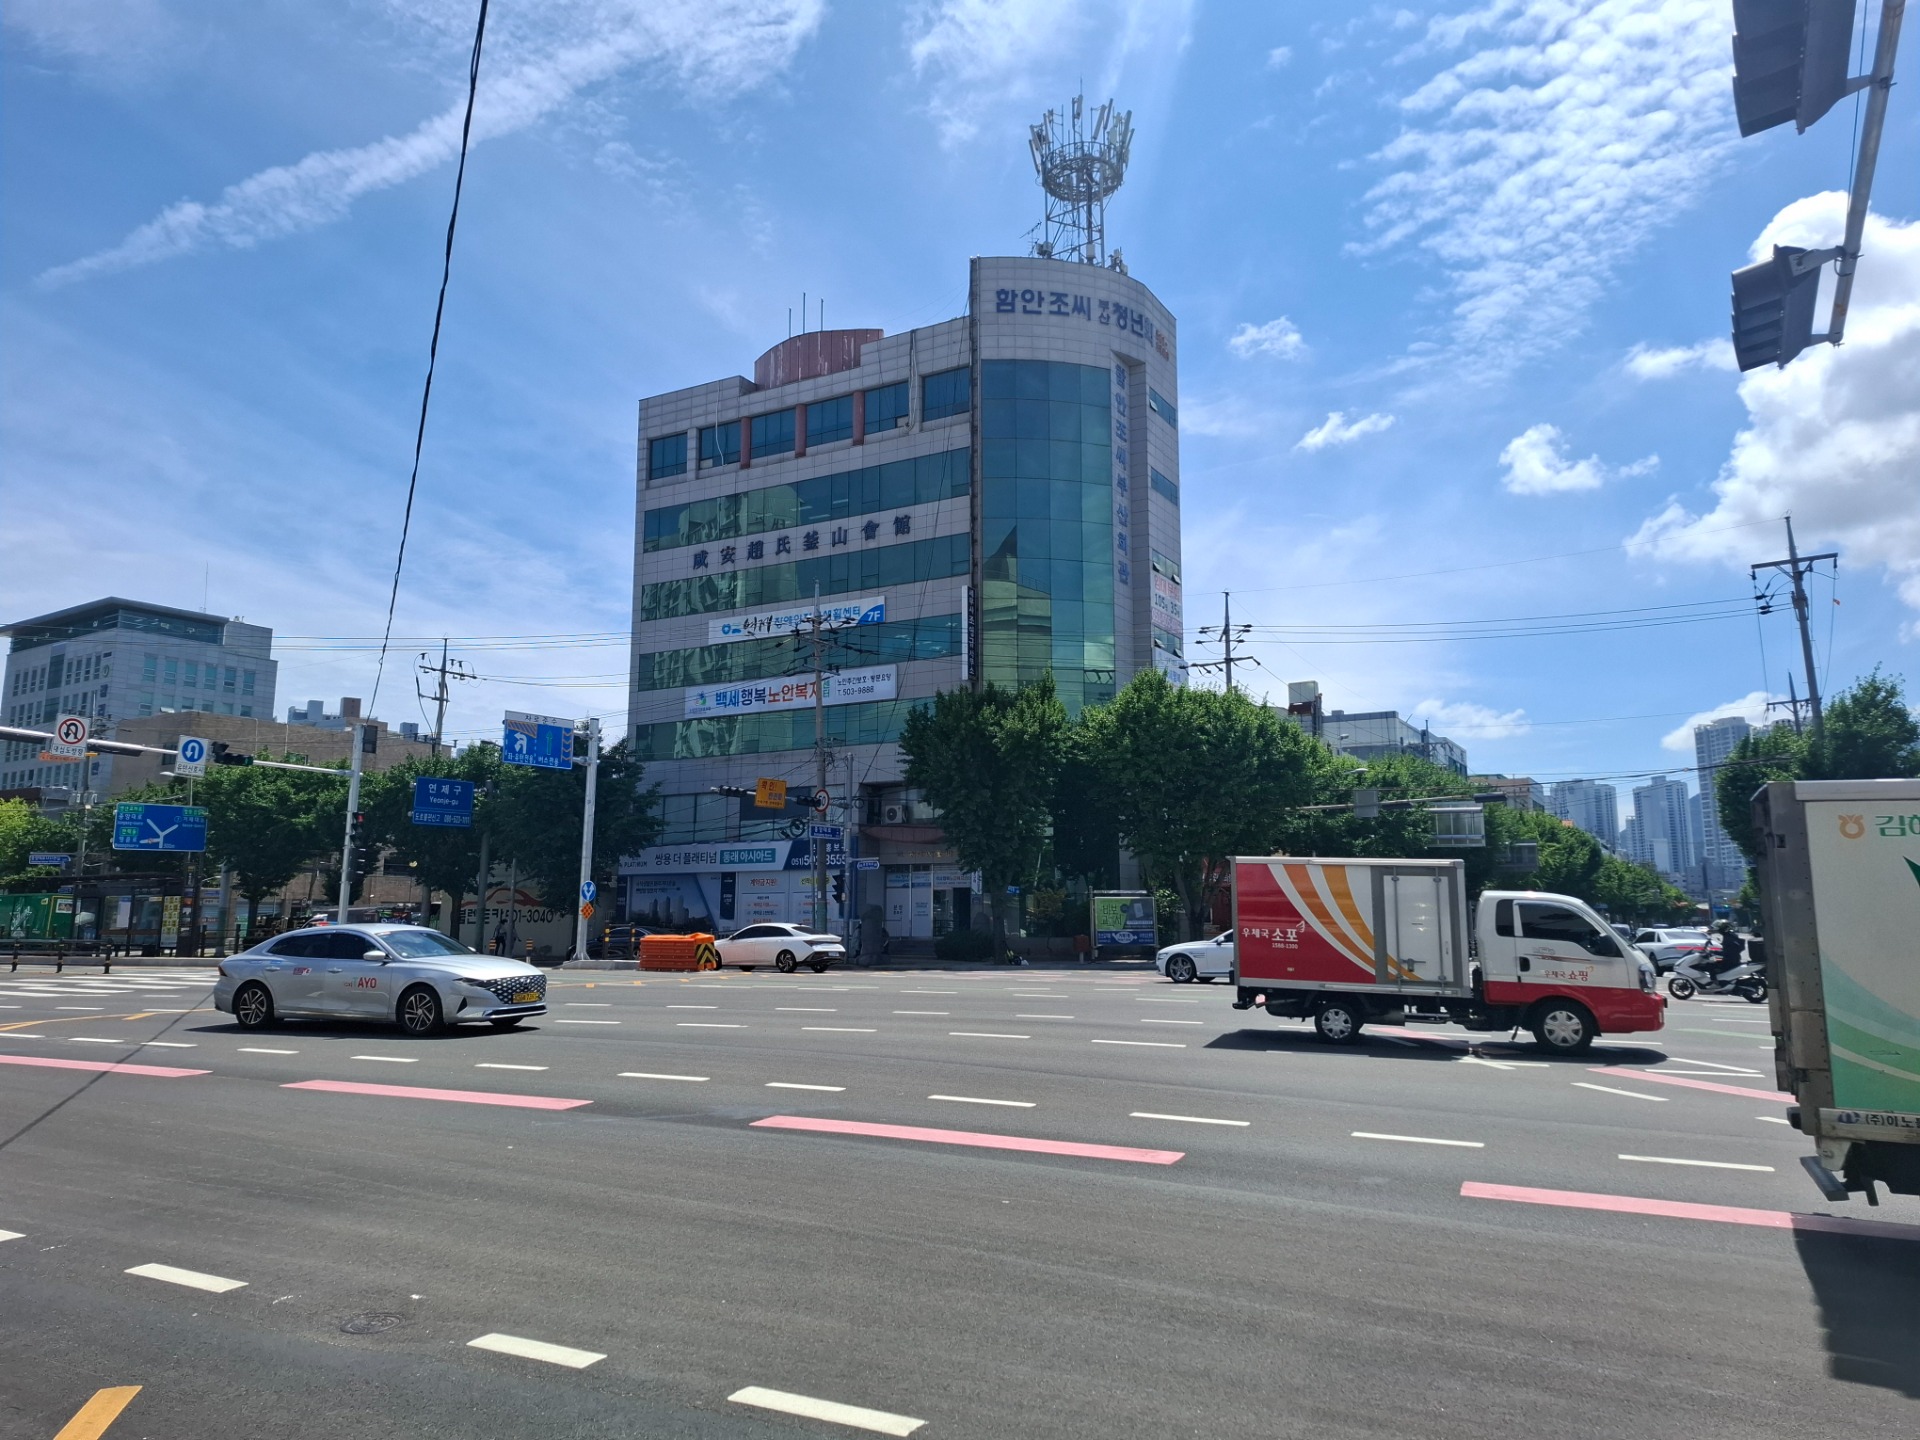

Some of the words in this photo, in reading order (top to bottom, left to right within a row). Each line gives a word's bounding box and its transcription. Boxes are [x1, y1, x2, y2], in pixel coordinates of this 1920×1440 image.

[995, 288, 1091, 321] 함안조씨
[867, 610, 881, 621] 7F
[525, 714, 557, 725] 차로준수
[428, 783, 462, 796] 연제구
[429, 796, 459, 806] Yeonje-gu
[655, 853, 671, 866] 쌍용
[674, 853, 681, 864] 더
[683, 851, 717, 865] 플래티넘
[723, 851, 739, 863] 동래
[741, 848, 773, 862] 아시아드
[1242, 927, 1269, 938] 우체국
[1271, 928, 1299, 942] 소포
[1545, 970, 1566, 978] 우체국
[1568, 970, 1588, 982] 쇼핑
[353, 977, 377, 988] TAYO
